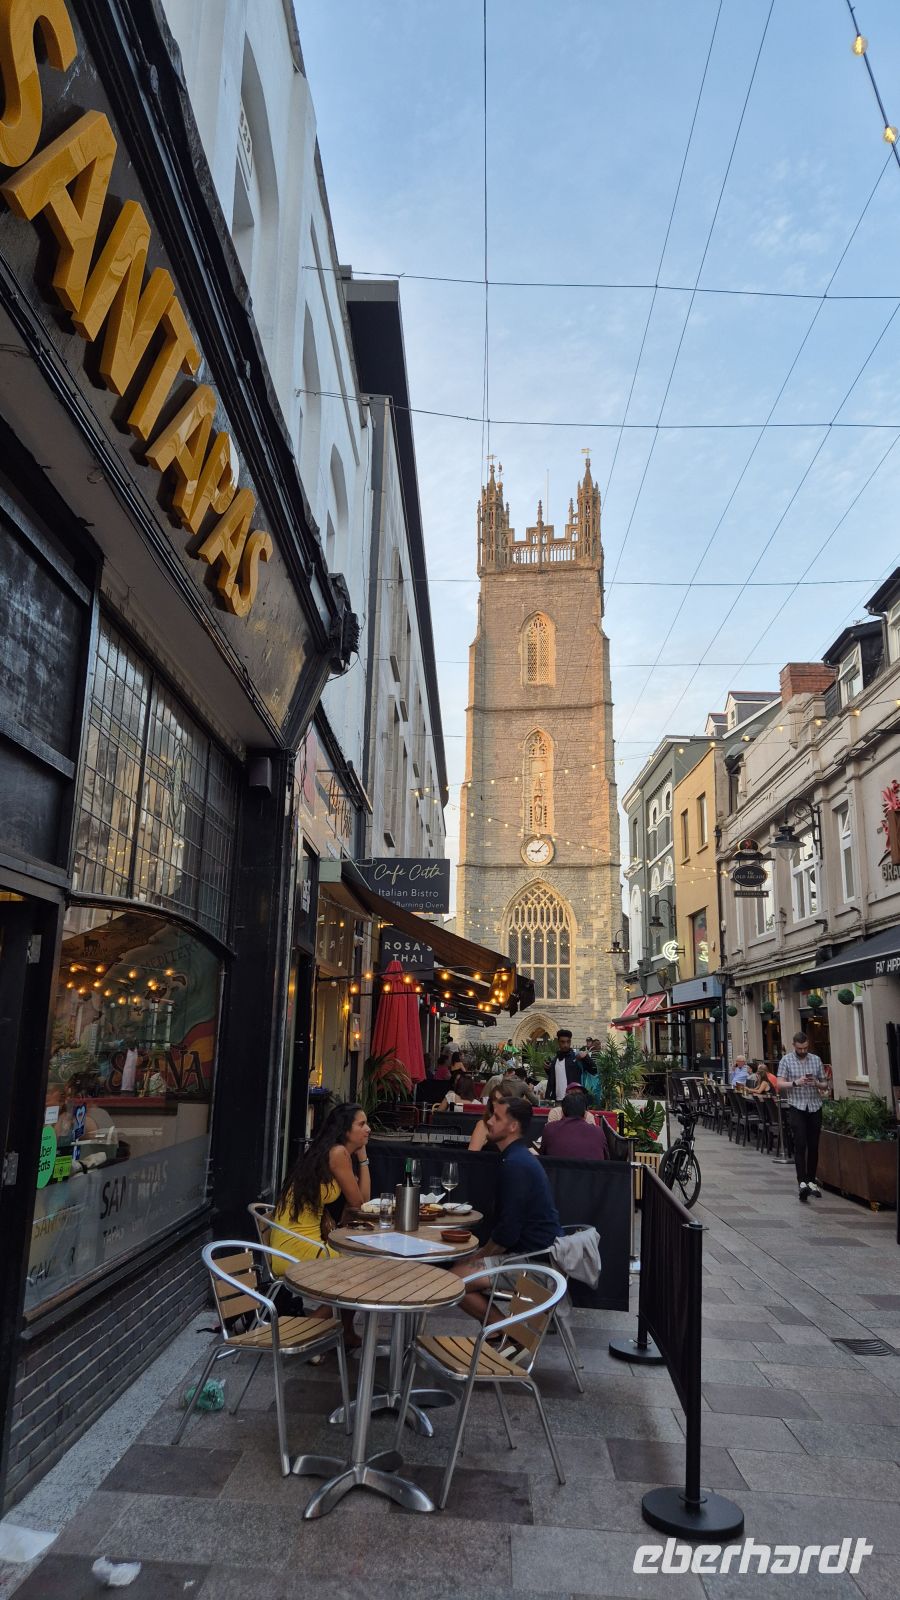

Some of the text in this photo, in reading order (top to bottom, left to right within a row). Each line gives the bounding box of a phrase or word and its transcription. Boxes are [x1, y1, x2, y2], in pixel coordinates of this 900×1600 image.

[378, 888, 439, 898] Italian Bistro
[392, 953, 423, 963] THAI
[875, 960, 886, 975] FAT
